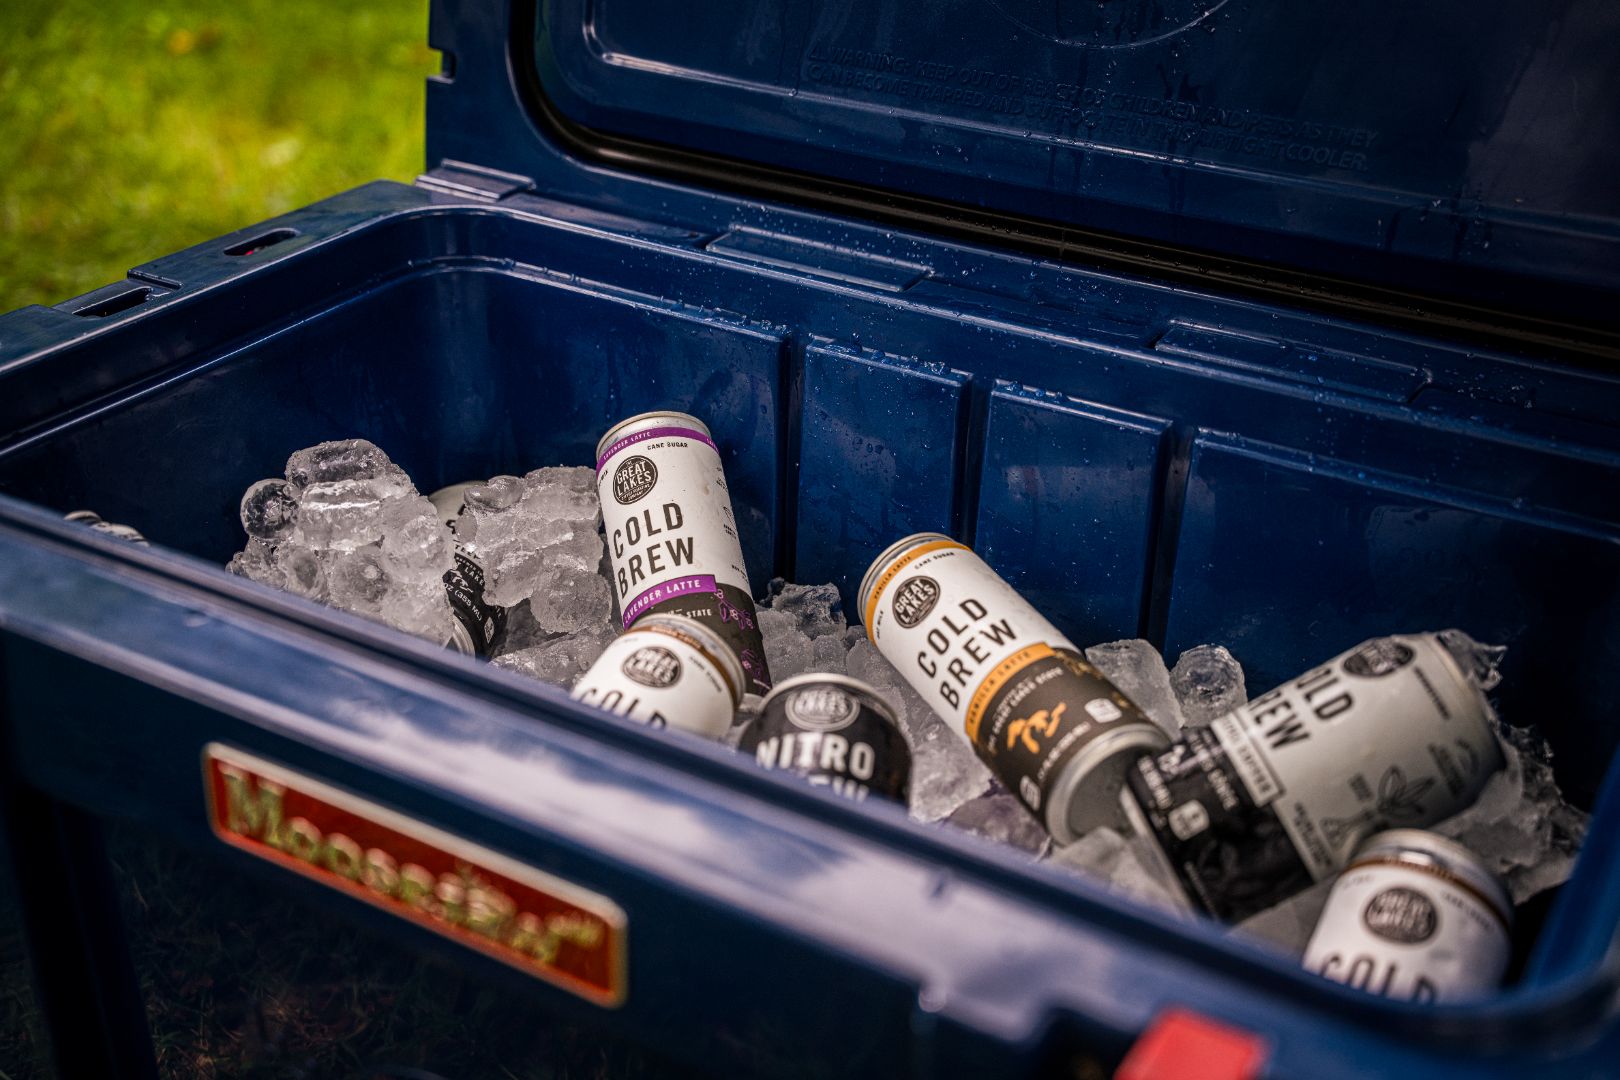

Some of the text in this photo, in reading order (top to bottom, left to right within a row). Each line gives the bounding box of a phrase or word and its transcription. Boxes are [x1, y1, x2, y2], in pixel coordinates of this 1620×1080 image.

[807, 63, 845, 85] CAN
[846, 69, 911, 95] BECOME
[912, 81, 984, 107] TRAPPED
[985, 94, 1025, 114] AND
[916, 59, 954, 82] KEEP
[958, 66, 996, 88] OUT
[996, 74, 1020, 91] OF
[1108, 92, 1200, 121] CHILDREN
[1202, 105, 1245, 127] AND
[1295, 120, 1323, 139] AS
[1327, 125, 1379, 148] THEY
[647, 441, 689, 451] CANE SUGAR
[616, 460, 647, 484] GREAT
[617, 470, 652, 497] LAKES
[613, 502, 684, 559] COLD
[617, 536, 694, 599] BREW
[625, 579, 701, 624] LAVENDER LATTE
[686, 608, 713, 619] STATE
[894, 579, 925, 614] GREAT
[900, 584, 936, 623] LAKES
[916, 597, 989, 679] COLD
[939, 617, 1017, 711] BREW
[756, 731, 876, 781] NITRO
